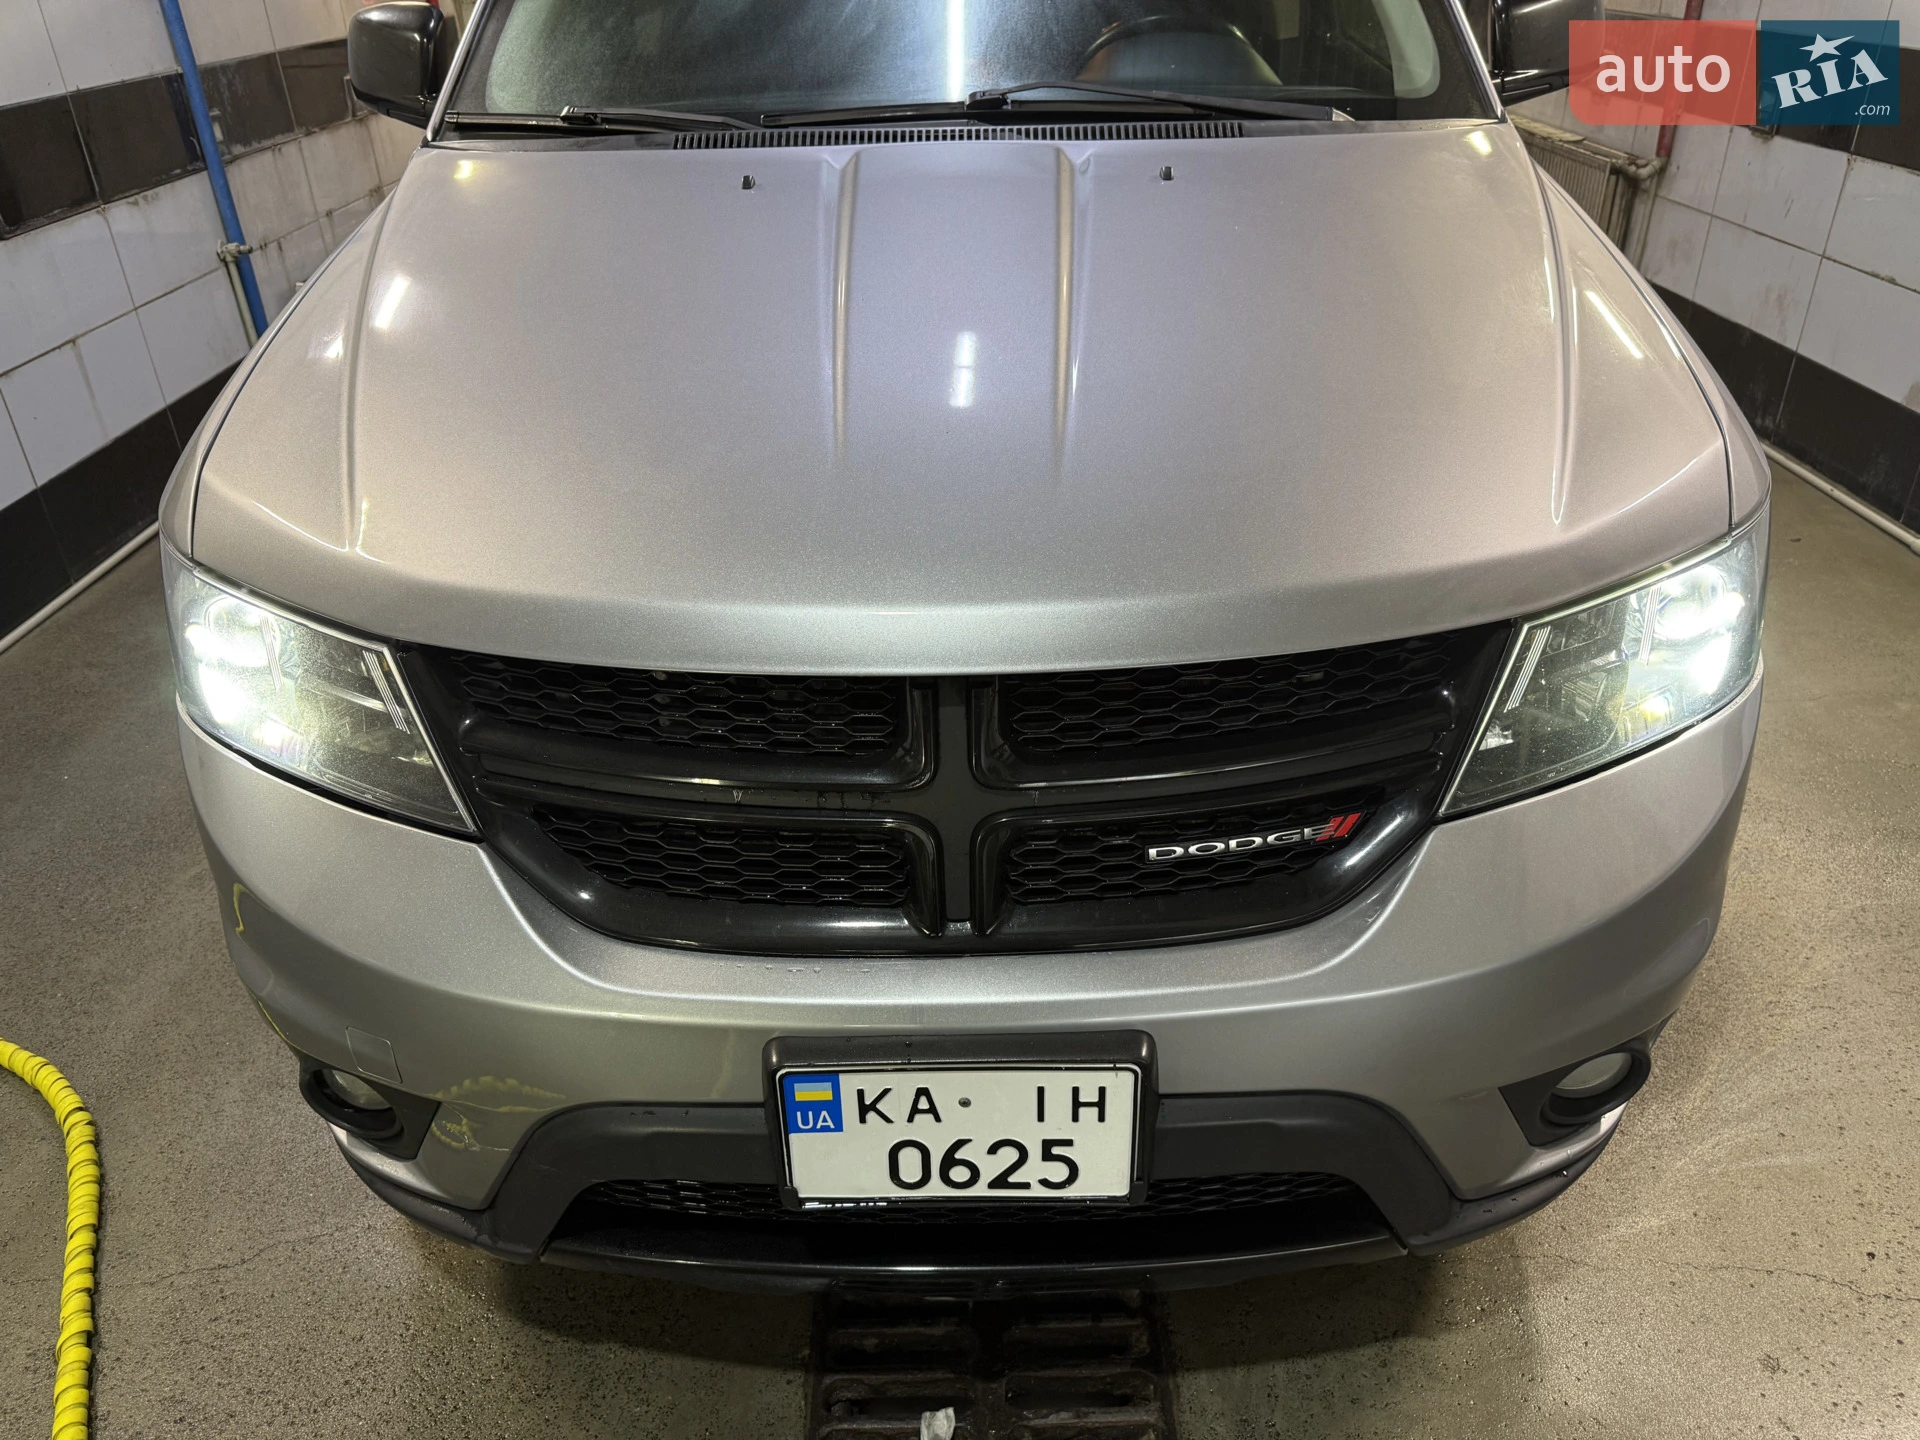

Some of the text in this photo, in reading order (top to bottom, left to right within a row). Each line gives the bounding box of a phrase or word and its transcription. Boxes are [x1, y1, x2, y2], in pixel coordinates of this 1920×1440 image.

[1148, 823, 1335, 861] DODGE
[797, 1111, 835, 1130] UA
[857, 1086, 1106, 1124] KA IH
[888, 1138, 1079, 1190] 0625
